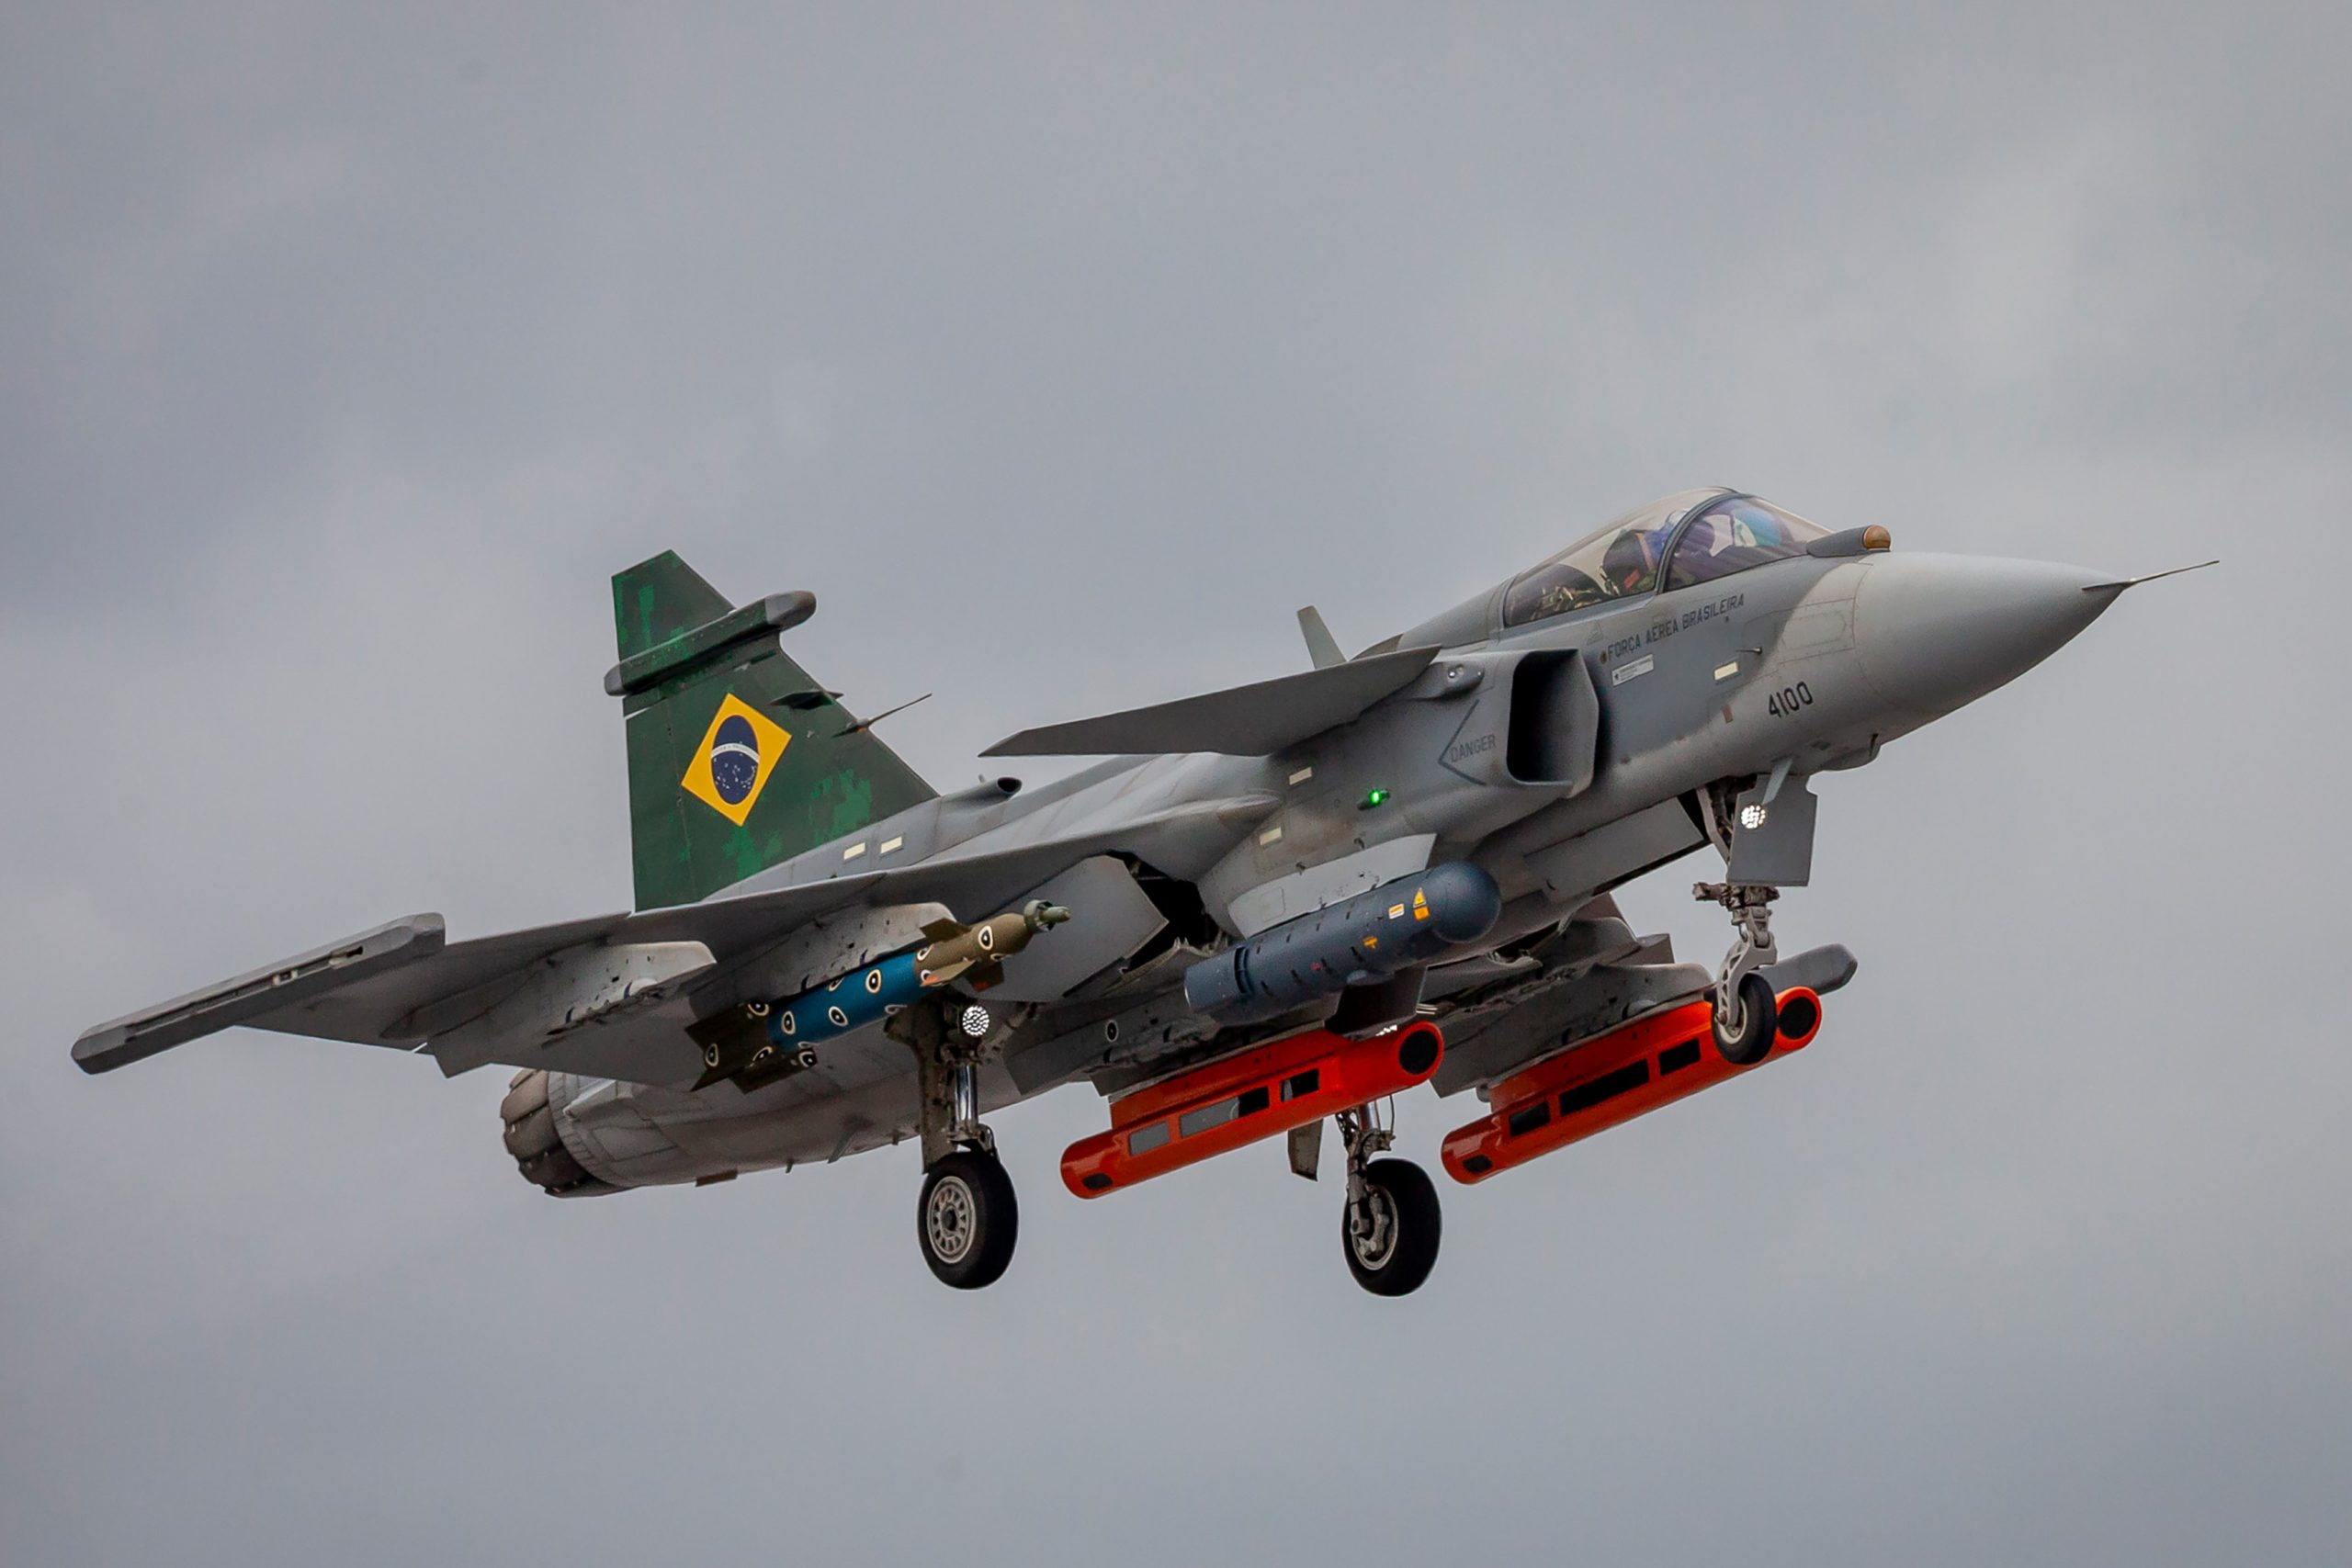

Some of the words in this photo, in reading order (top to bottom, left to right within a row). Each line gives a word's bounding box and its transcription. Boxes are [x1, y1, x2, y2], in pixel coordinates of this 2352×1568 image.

[1608, 635, 1640, 660] FORÇA
[1682, 593, 1744, 630] BRASILEIRA
[1769, 681, 1814, 717] 4100
[1451, 733, 1497, 762] DANGER
